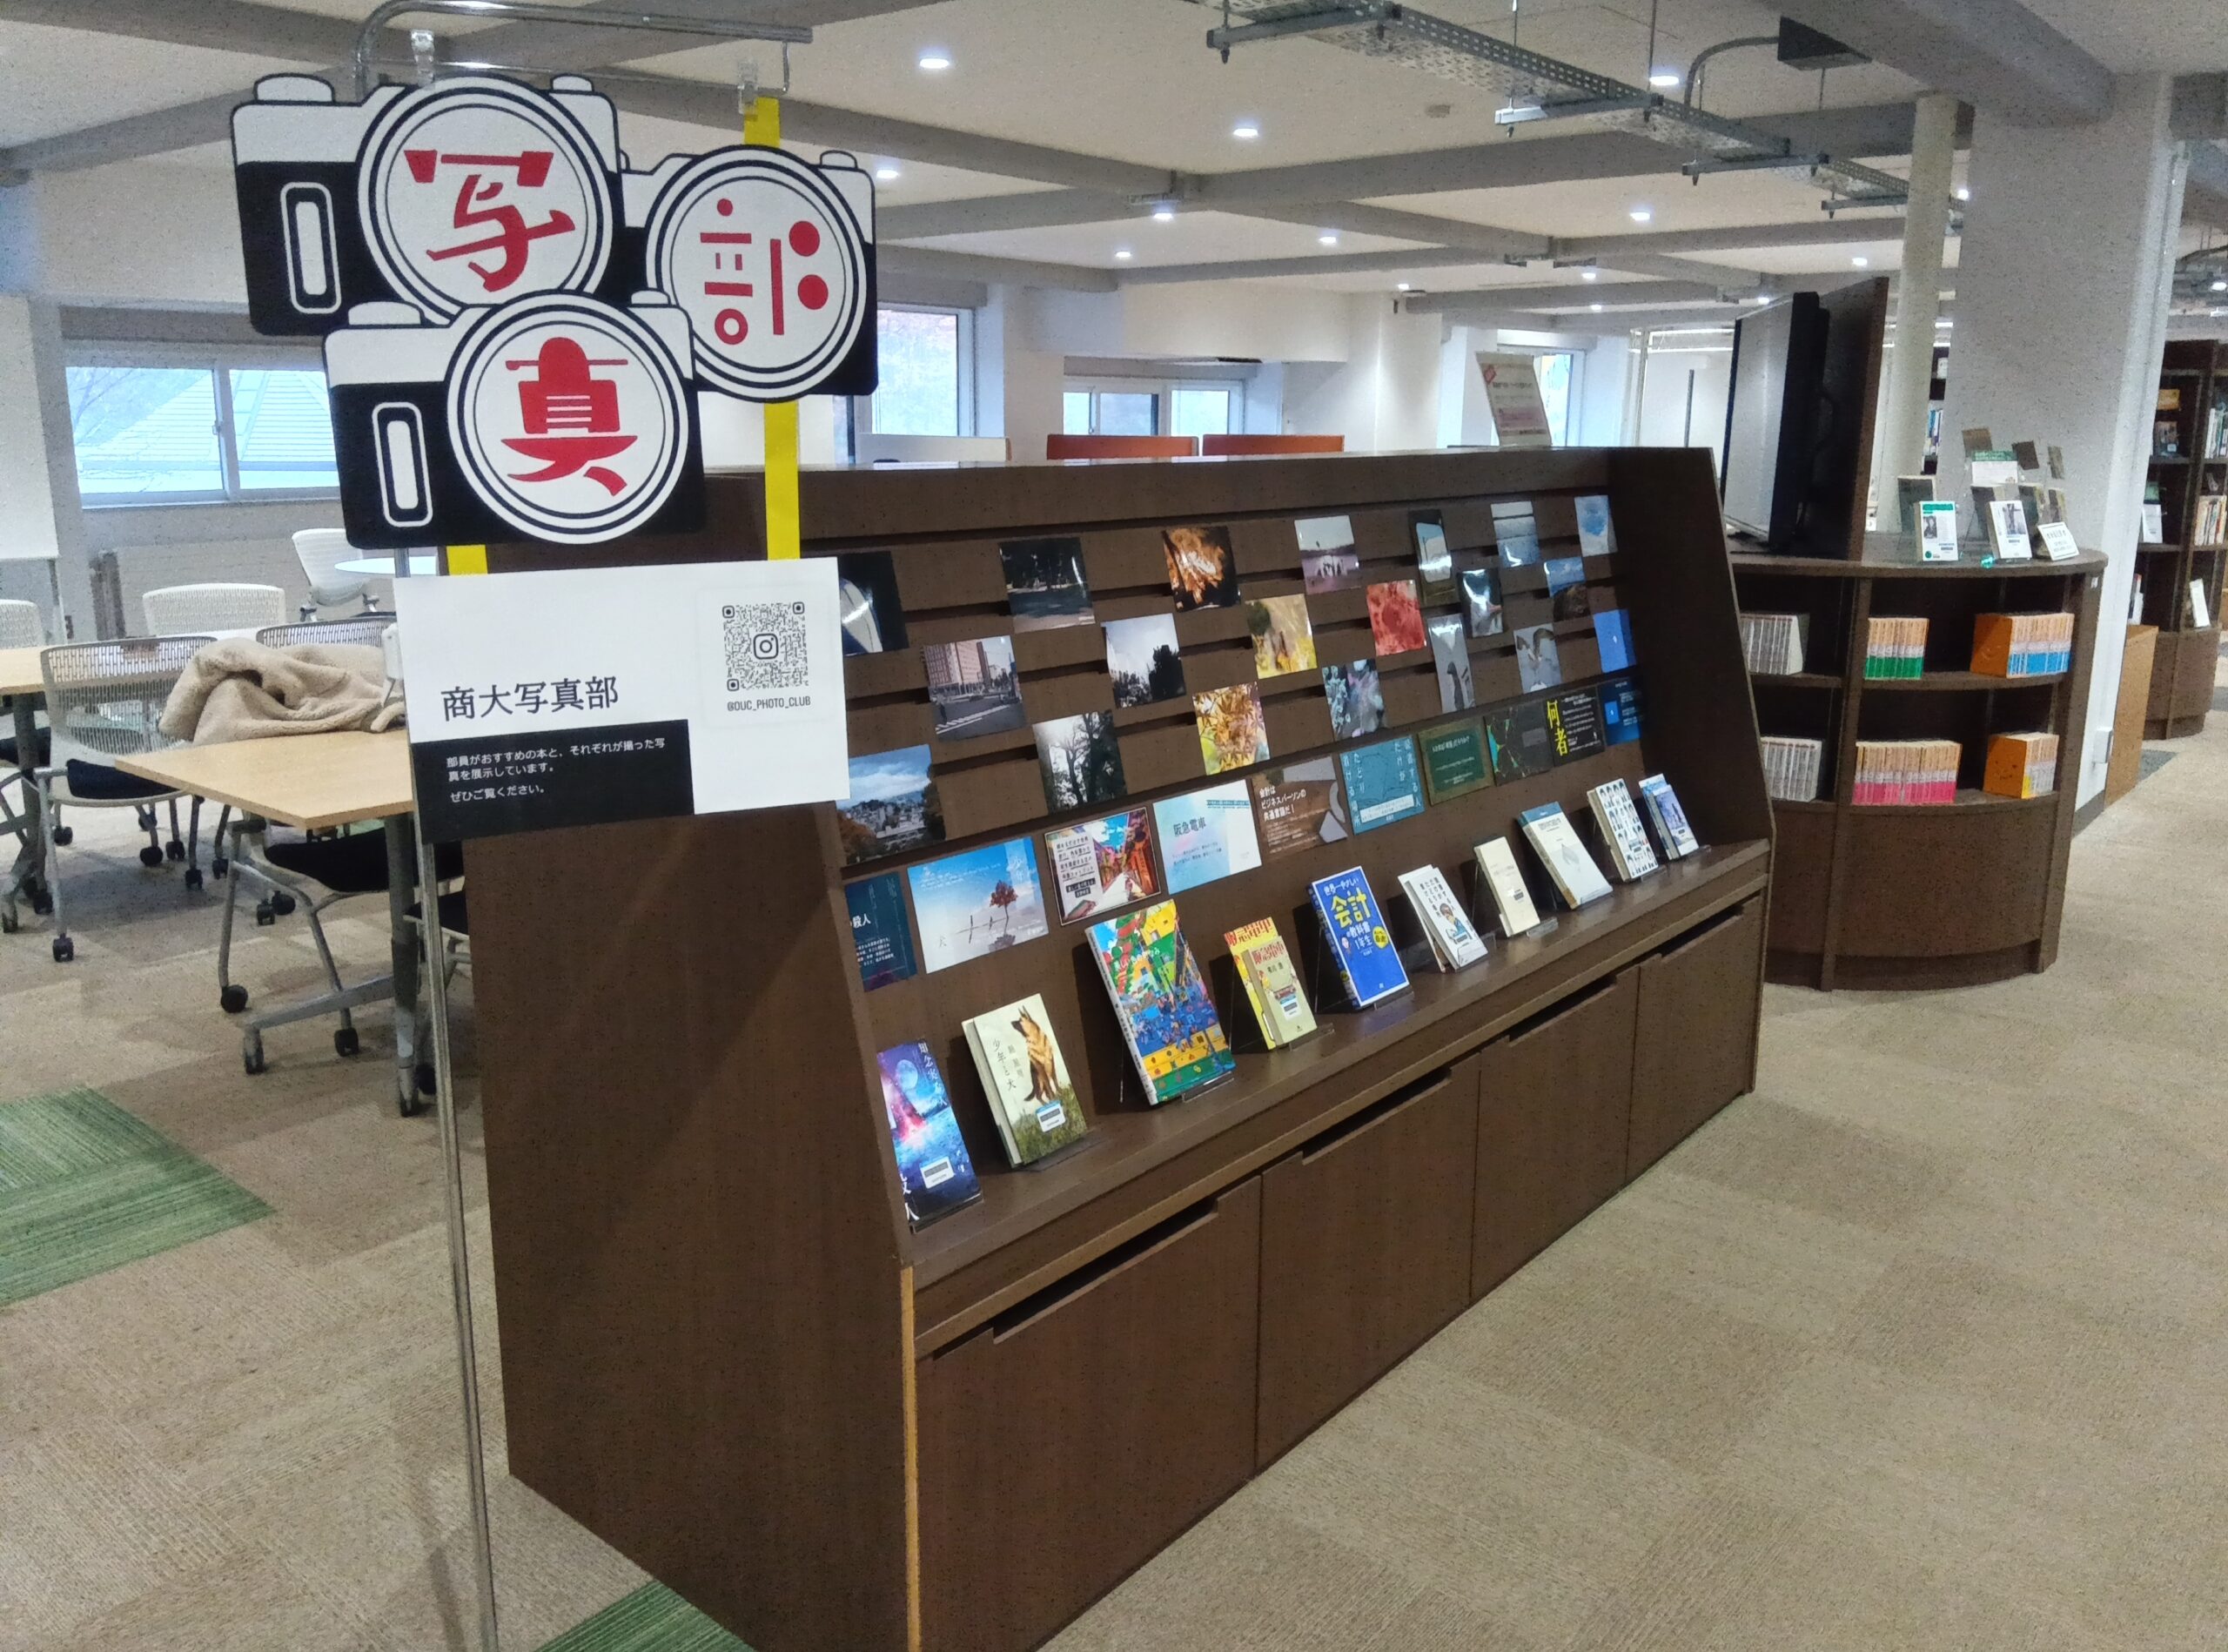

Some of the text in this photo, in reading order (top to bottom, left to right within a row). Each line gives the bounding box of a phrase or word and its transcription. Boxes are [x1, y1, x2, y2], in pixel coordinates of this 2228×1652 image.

[403, 149, 576, 292] 写
[501, 335, 639, 497] 真
[440, 675, 619, 722] 商大写真部
[728, 695, 811, 711] @OUC_PHOTO_CLUB
[1547, 700, 1567, 756] 何者
[448, 762, 554, 782] 真を展示しています。
[450, 784, 545, 803] ぜひご覧ください。
[1173, 816, 1206, 836] 阪急電車
[1331, 887, 1371, 929] 会計
[993, 1038, 1017, 1091] 少年と犬
